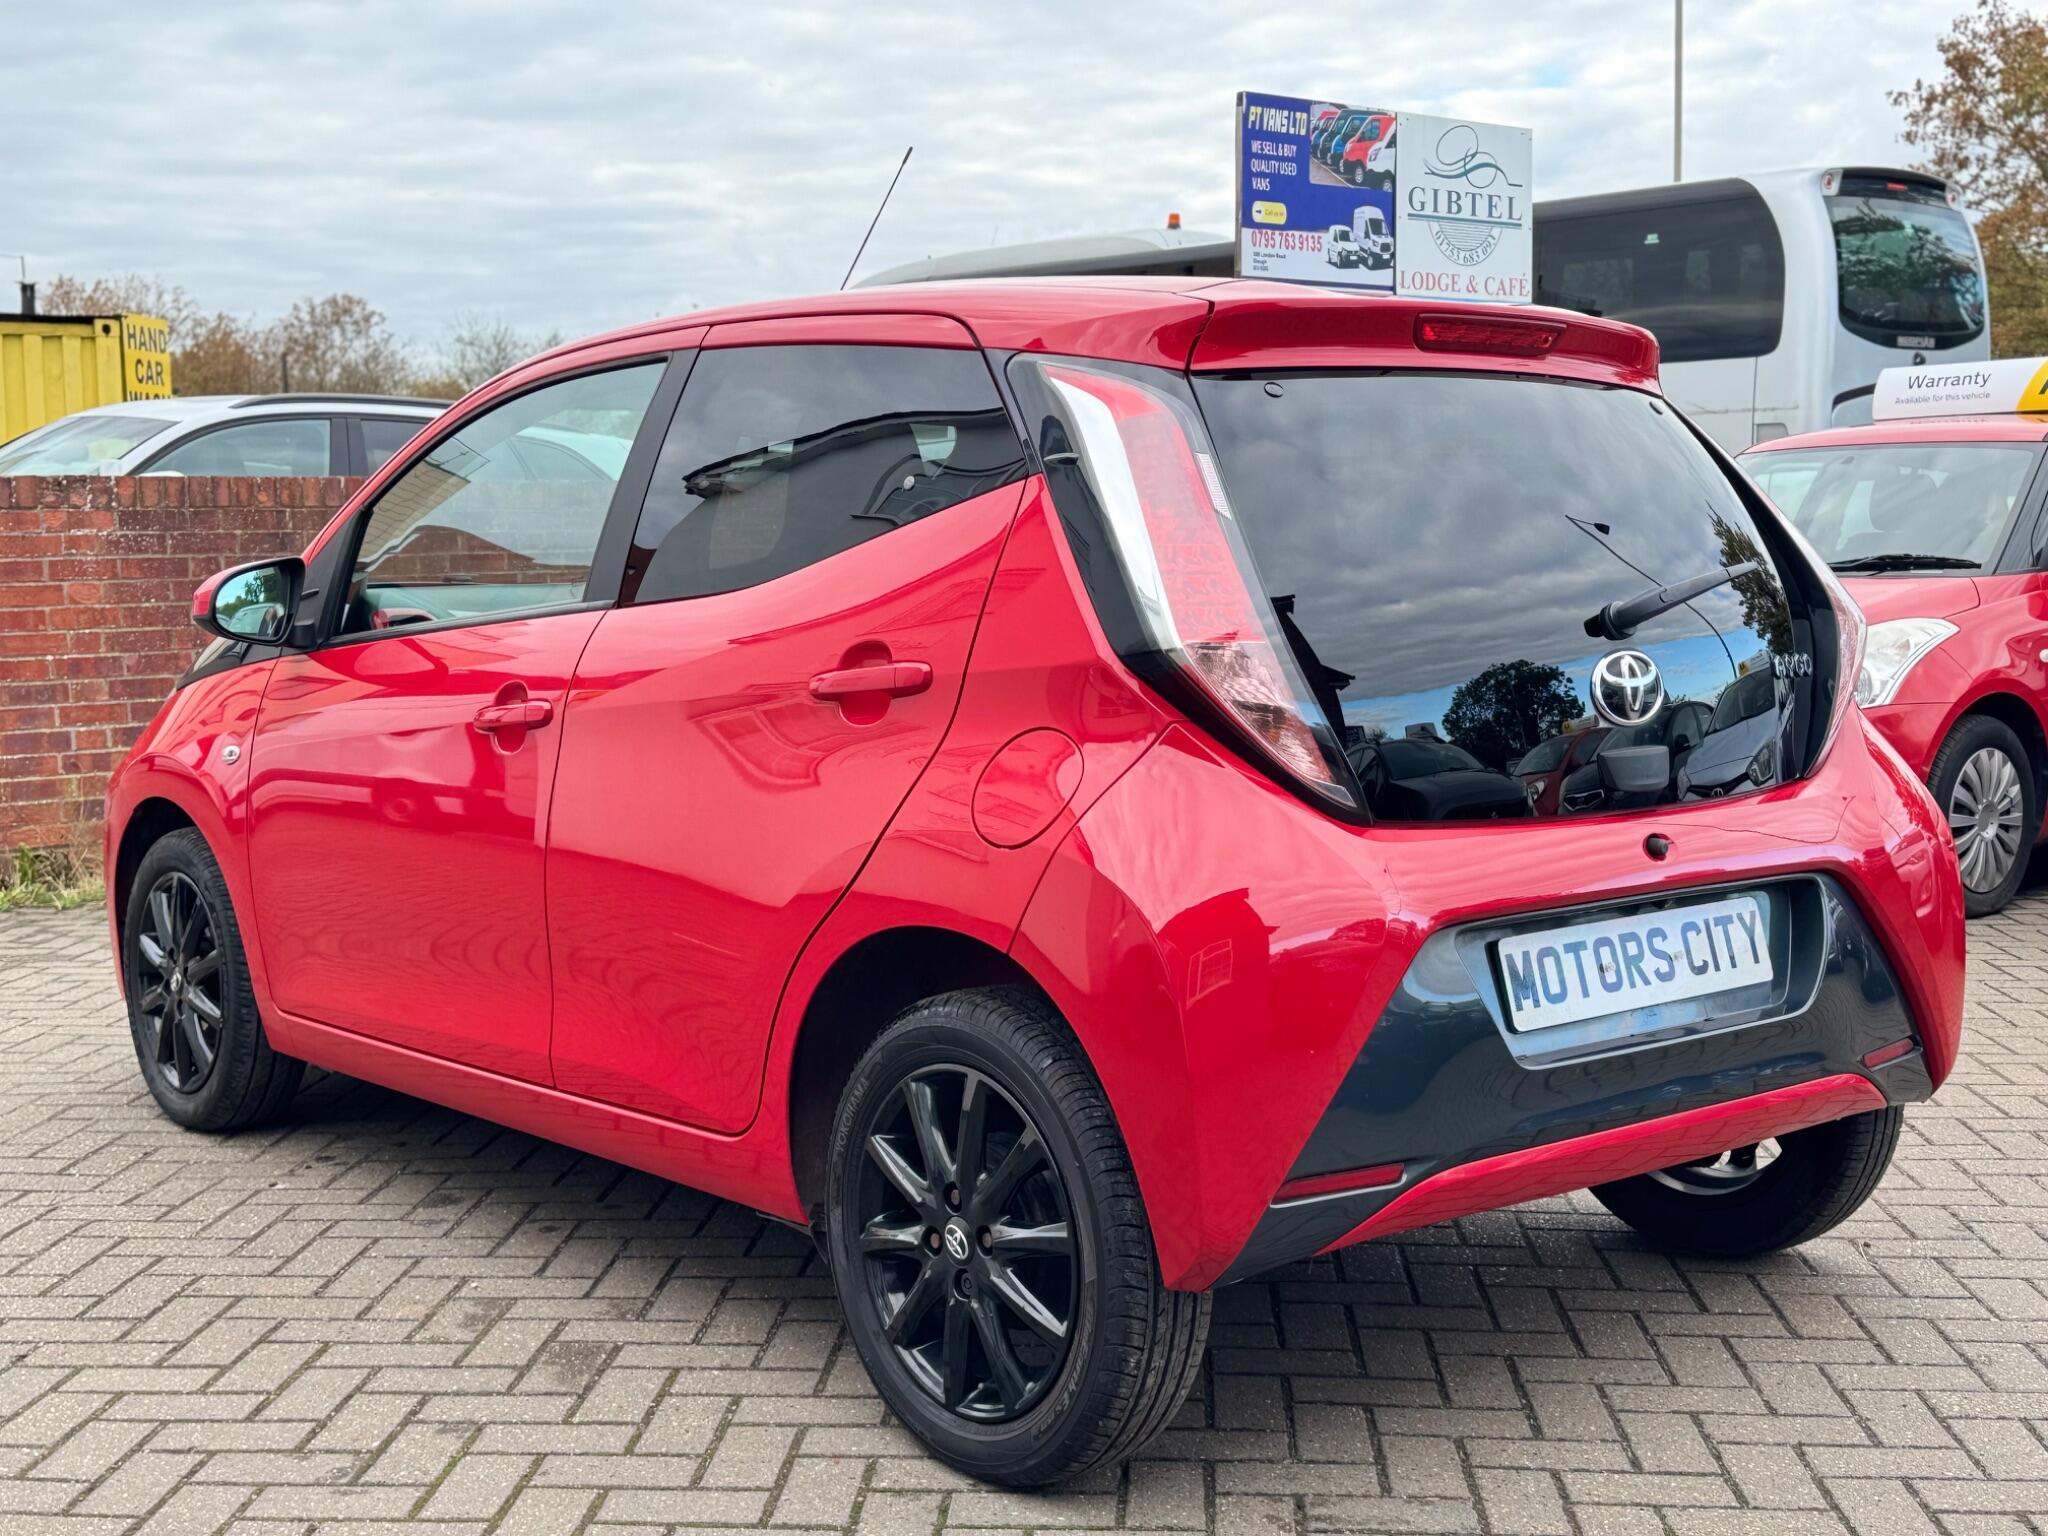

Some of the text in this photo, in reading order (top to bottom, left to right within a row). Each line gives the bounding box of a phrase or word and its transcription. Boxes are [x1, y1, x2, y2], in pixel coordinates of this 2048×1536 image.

[1248, 106, 1308, 136] PT VANS LTD
[1251, 140, 1297, 157] WE SELL & BUY
[1251, 158, 1297, 176] QUALITY USED
[1252, 177, 1271, 191] VANS
[1408, 186, 1522, 221] GIBTEL
[1251, 230, 1322, 252] 0795 763 9135
[1400, 270, 1530, 297] LODGE & CAFÉ
[126, 323, 167, 354] HAND
[135, 358, 165, 386] CAR
[1908, 372, 1992, 390] Warranty
[1894, 391, 1990, 404] Available for this vehicle
[1774, 653, 1812, 677] AYGO
[1505, 910, 1761, 1012] MOTORS CITY
